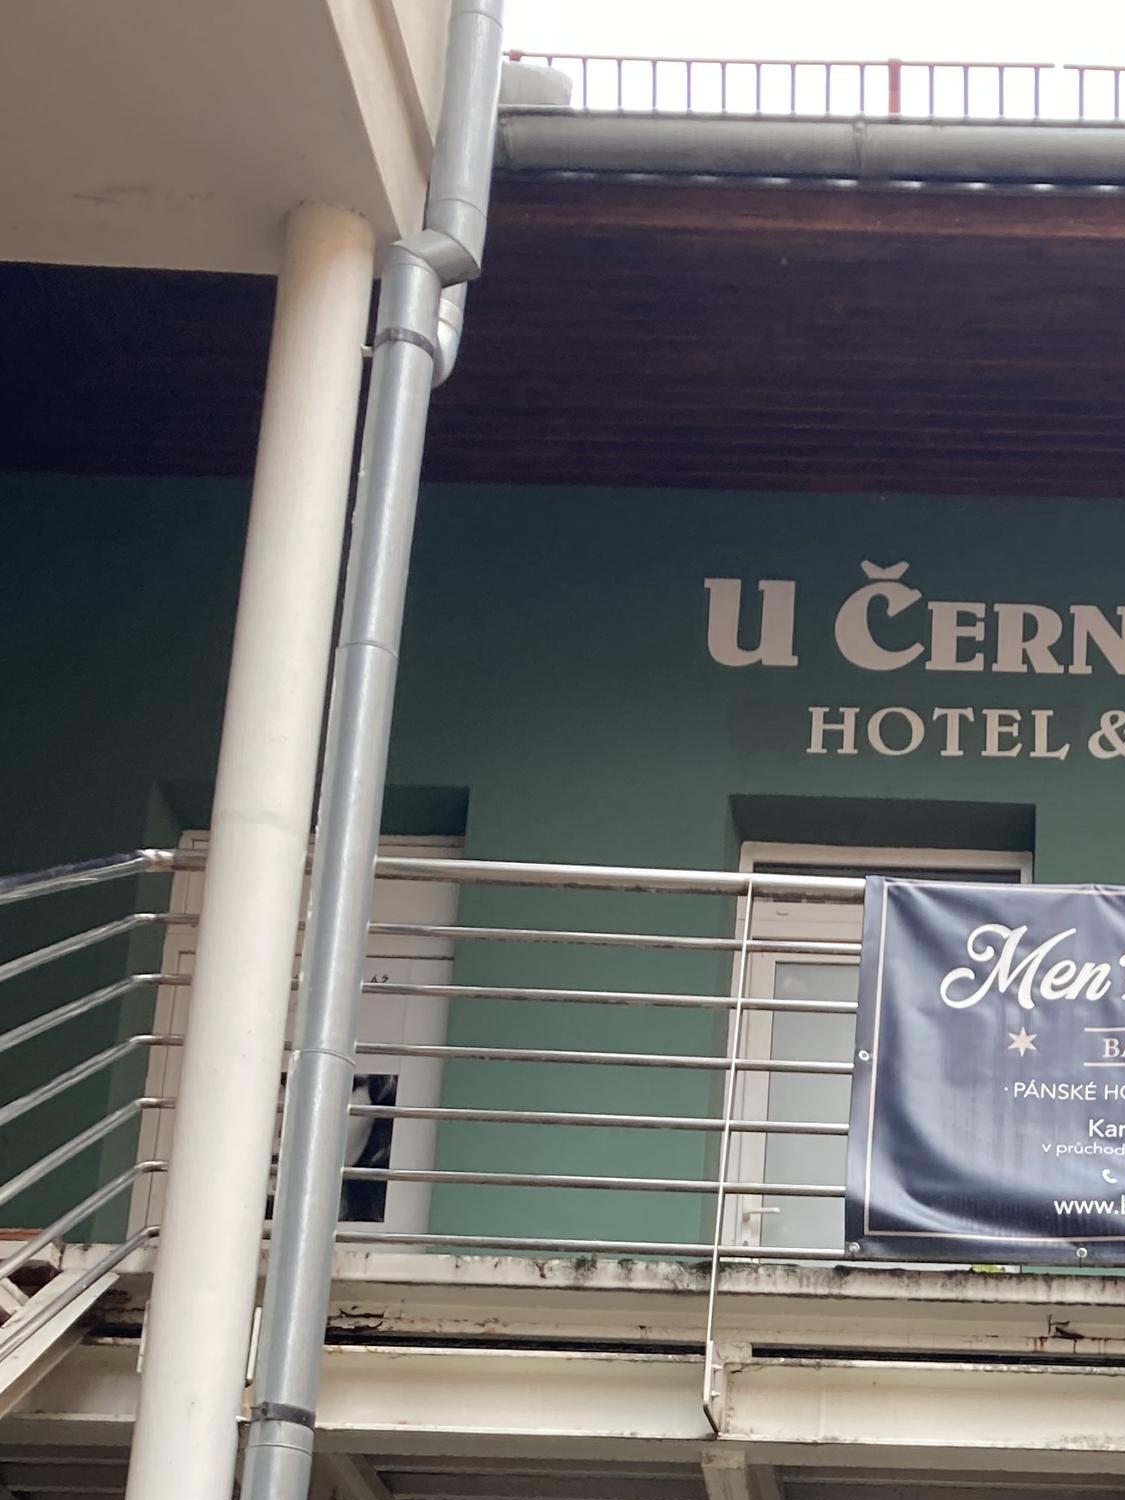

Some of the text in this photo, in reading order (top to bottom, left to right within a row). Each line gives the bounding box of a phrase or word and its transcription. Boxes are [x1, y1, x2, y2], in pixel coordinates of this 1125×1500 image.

[804, 705, 1071, 761] HOTEL
[1013, 1079, 1097, 1101] PÁNSKÉ
[1041, 1142, 1052, 1153] v
